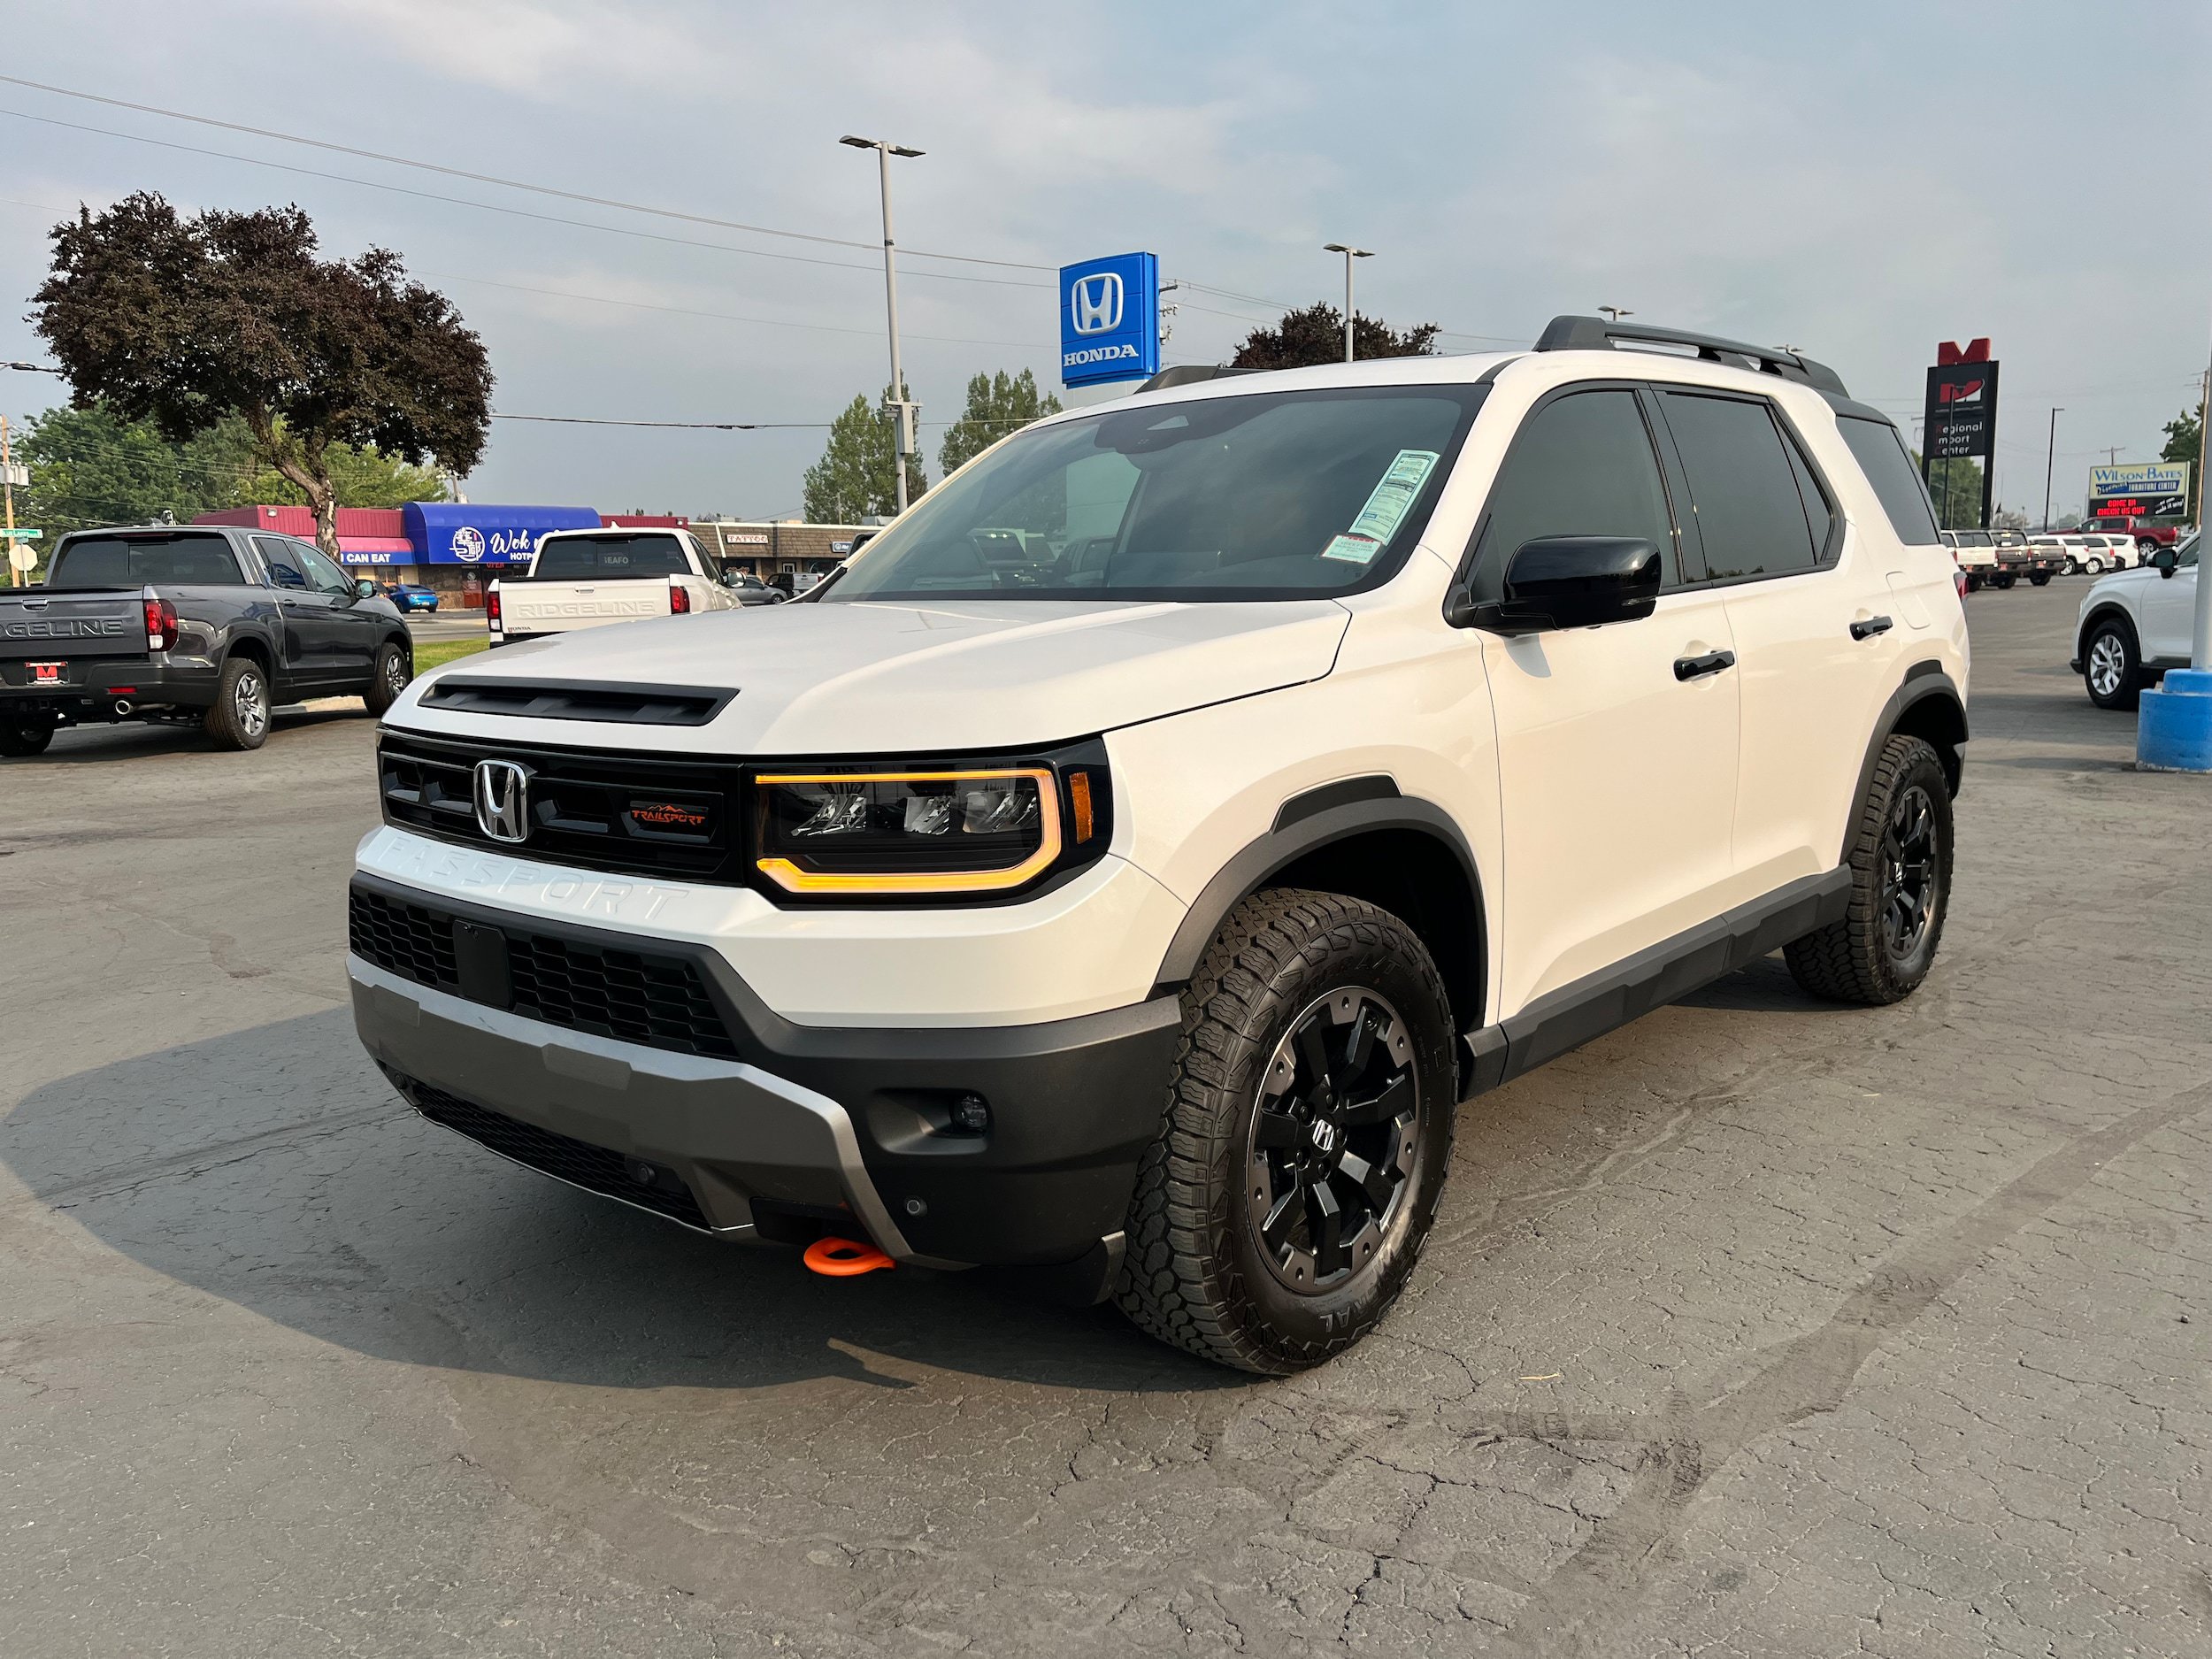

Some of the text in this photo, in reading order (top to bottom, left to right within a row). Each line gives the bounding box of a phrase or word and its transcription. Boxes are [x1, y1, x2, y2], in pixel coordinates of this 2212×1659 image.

[1064, 344, 1140, 367] HONDA
[490, 529, 529, 555] Wok
[346, 553, 369, 563] CAN
[371, 553, 391, 563] EAT
[516, 601, 656, 618] RIDGELINE
[631, 810, 706, 826] TRAILSPORT
[376, 835, 692, 922] PASSPORT
